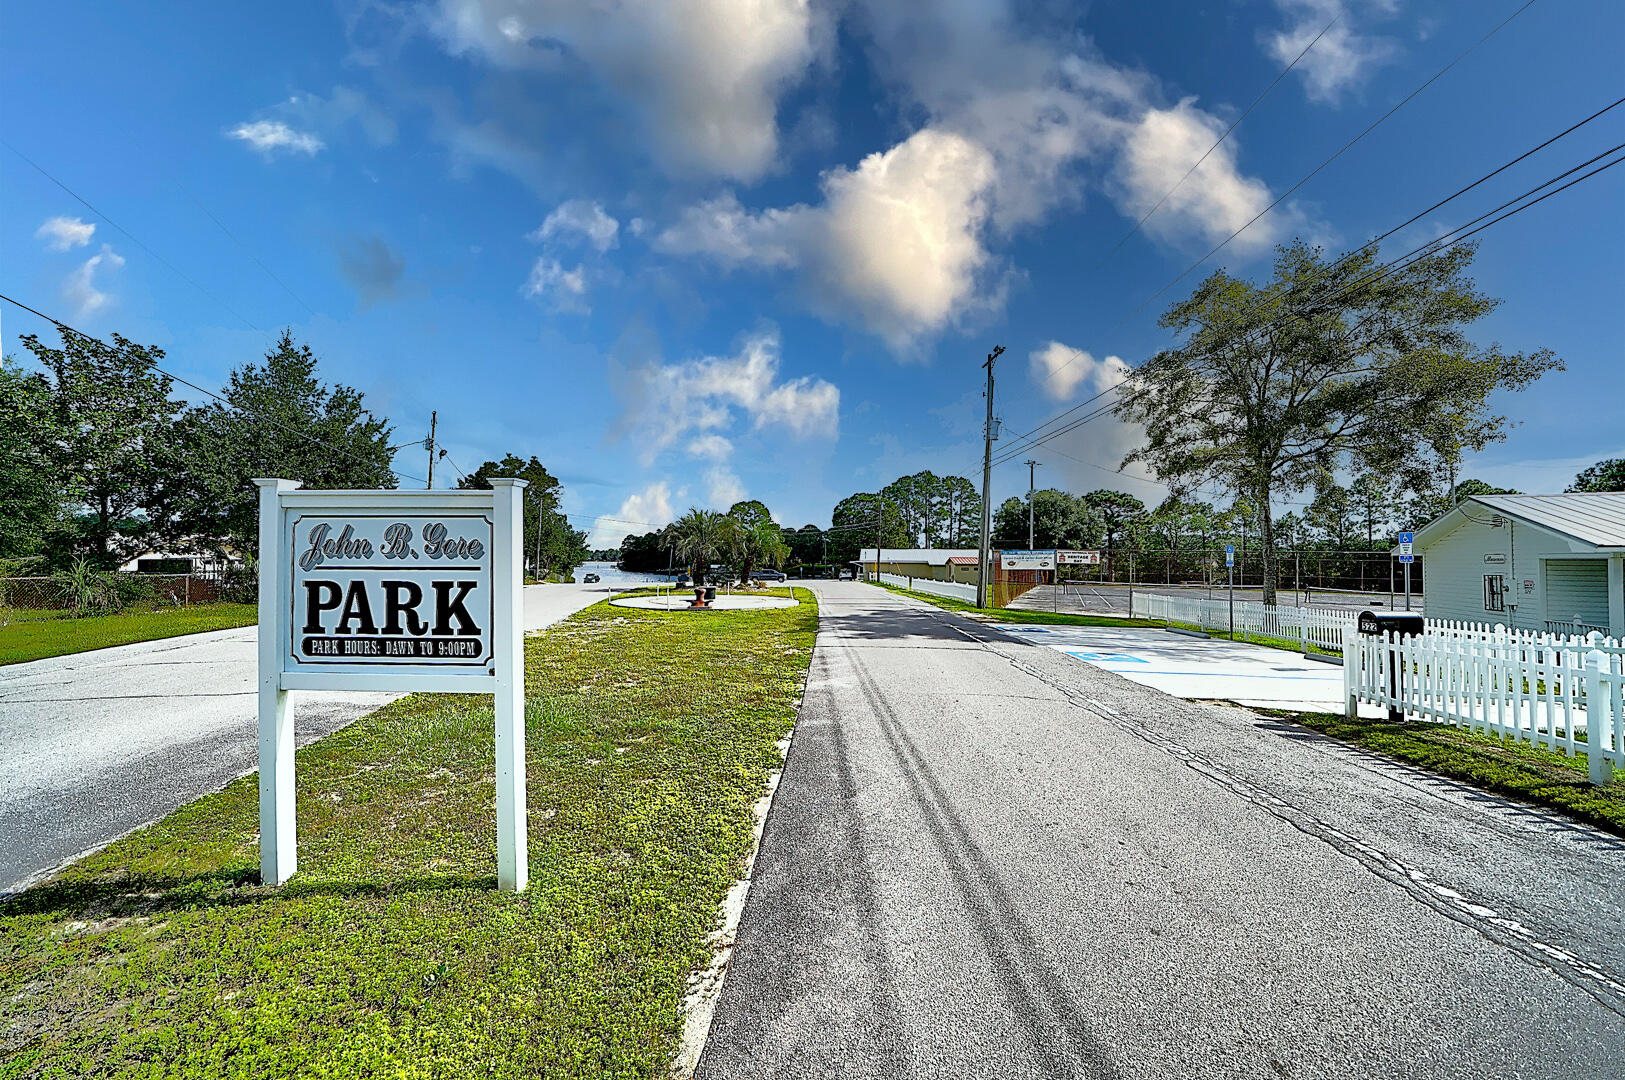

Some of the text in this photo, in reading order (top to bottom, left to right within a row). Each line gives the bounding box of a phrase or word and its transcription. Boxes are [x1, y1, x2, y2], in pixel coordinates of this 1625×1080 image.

[299, 522, 485, 572] John B. Gore
[302, 580, 482, 636] PARK
[1362, 622, 1377, 631] 522
[311, 639, 475, 656] PARK HOURS: DAWN TO 9:00PM
